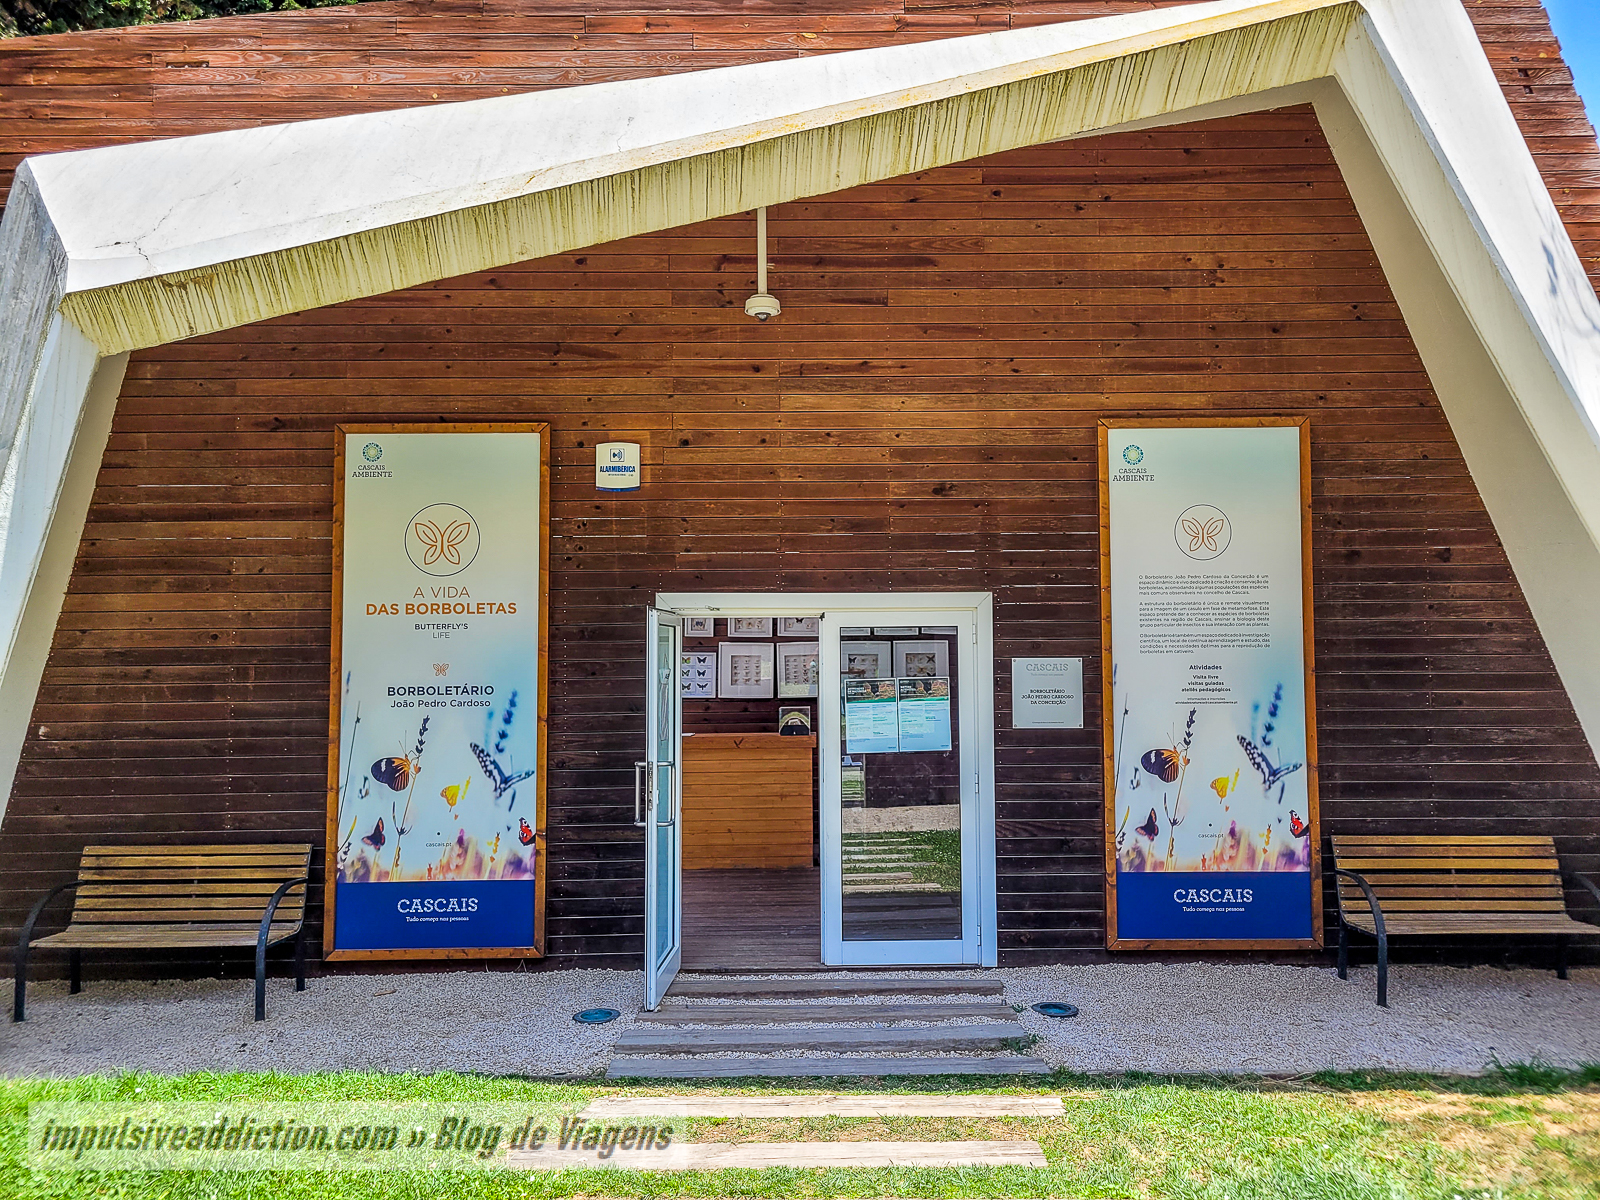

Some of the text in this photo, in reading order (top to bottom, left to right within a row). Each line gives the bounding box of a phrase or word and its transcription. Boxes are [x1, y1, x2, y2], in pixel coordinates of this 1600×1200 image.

[413, 586, 470, 599] A VIDA
[366, 603, 517, 615] DAS BORBOLETAS
[387, 683, 494, 696] BORBOLETÁRIO
[391, 698, 491, 708] João Pedro Cardoso
[1174, 889, 1253, 903] CASCAIS
[397, 898, 479, 913] CASCAIS
